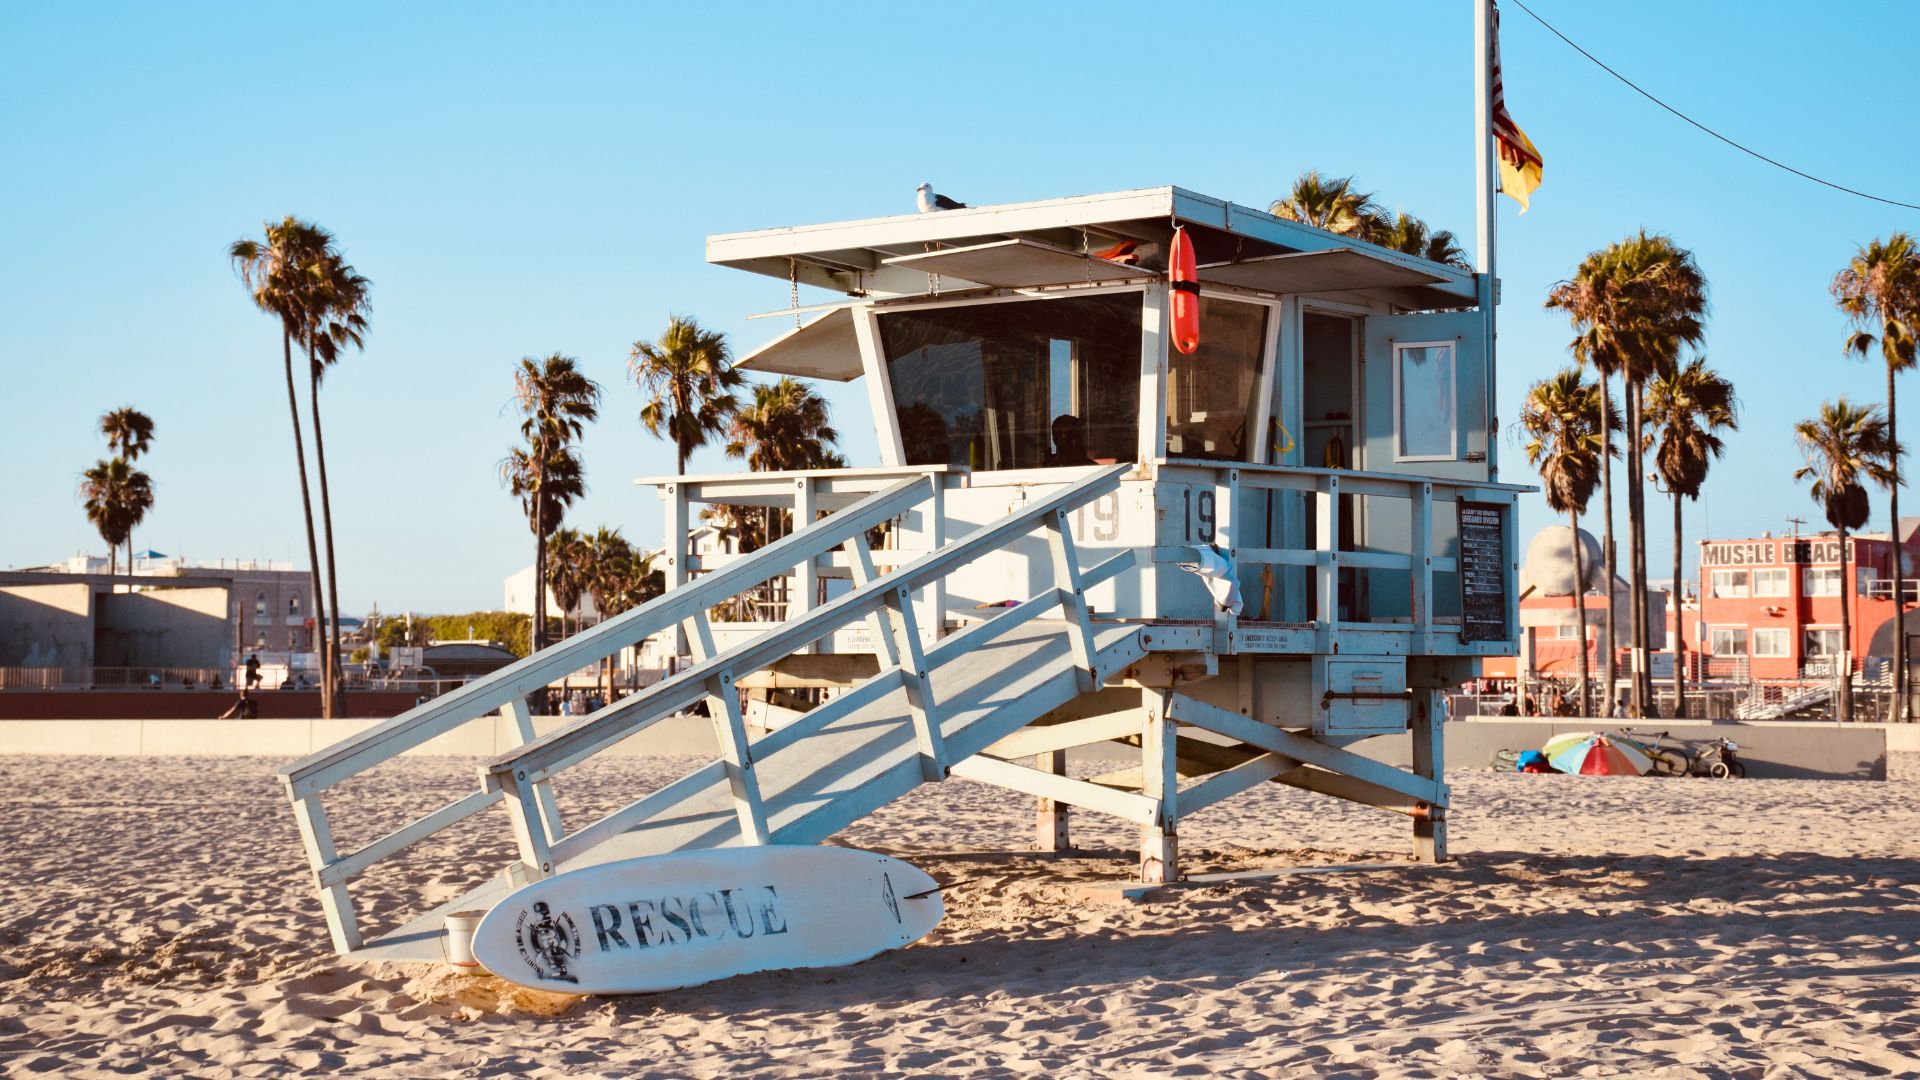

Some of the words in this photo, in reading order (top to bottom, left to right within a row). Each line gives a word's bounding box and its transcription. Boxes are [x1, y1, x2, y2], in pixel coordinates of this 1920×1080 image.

[1077, 490, 1120, 542] 19
[1184, 489, 1217, 543] 19
[1703, 543, 1774, 565] MUSCLE
[1783, 542, 1854, 564] BEACH
[589, 884, 789, 953] RESCUE
[525, 955, 544, 975] COUNTY
